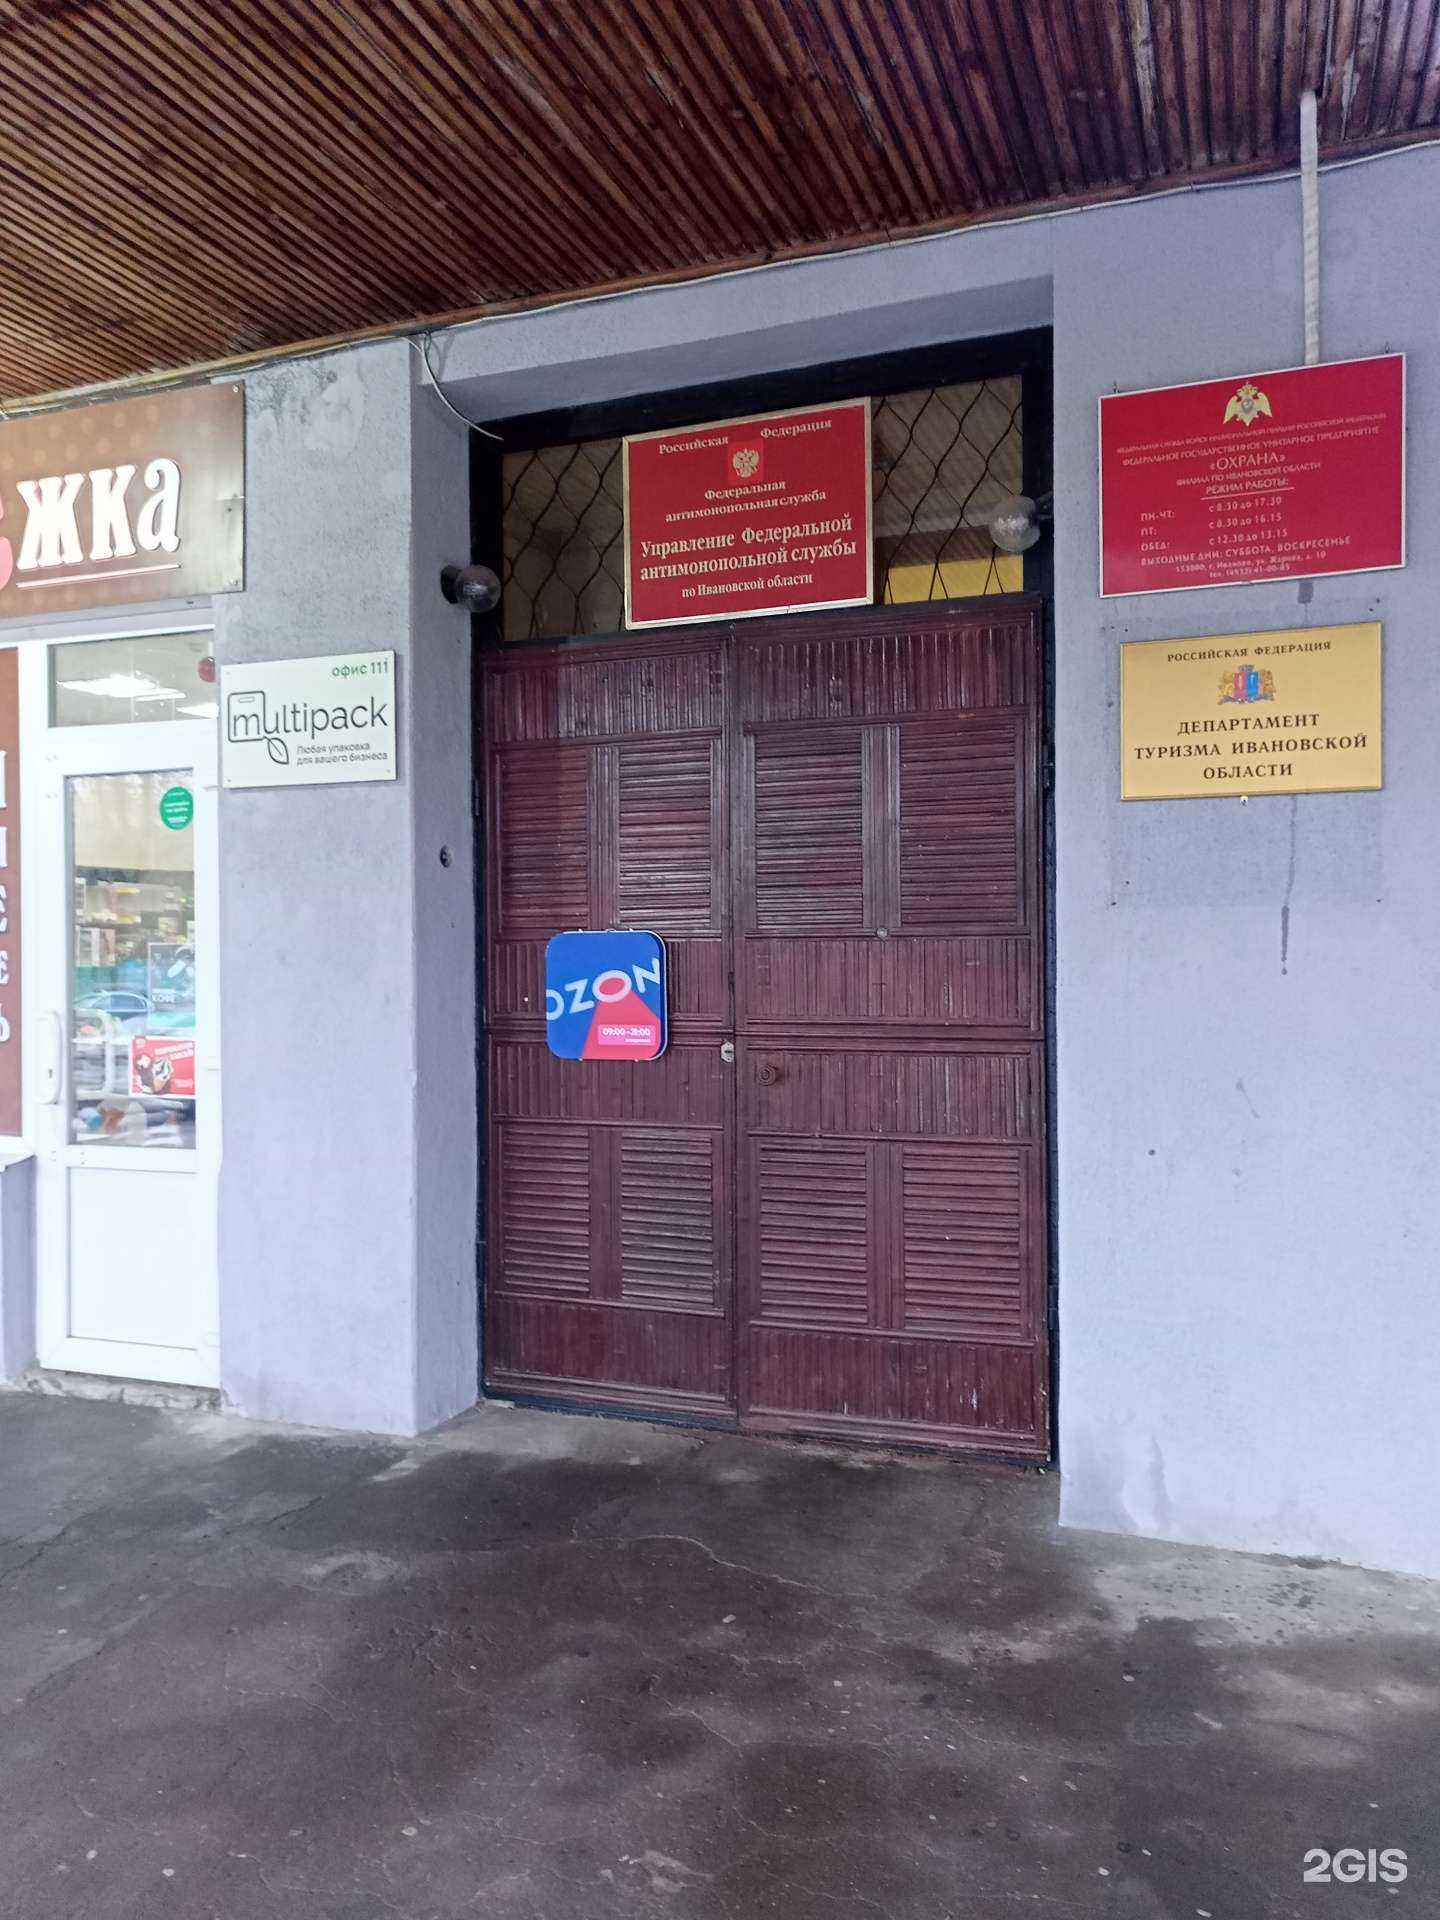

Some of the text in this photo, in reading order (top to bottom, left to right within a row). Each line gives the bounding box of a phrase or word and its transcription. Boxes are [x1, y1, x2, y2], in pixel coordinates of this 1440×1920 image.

[658, 419, 832, 455] Российская Федерация
[1210, 451, 1286, 470] «ОХРАНА»
[1211, 473, 1224, 482] ПО
[1283, 461, 1321, 473] ОБЛАСТИ
[704, 480, 786, 501] Федеральная
[1205, 478, 1289, 495] РЕЖИМ РАБОТЫ:
[665, 489, 827, 523] антимонопольная служба
[1240, 502, 1252, 510] до
[1240, 517, 1252, 526] до
[1255, 512, 1282, 523] 16.15
[640, 514, 853, 559] Управление Федеральной
[640, 538, 857, 581] антимонопольной службы
[1140, 552, 1195, 566] ВЫХОДНЫЕ
[681, 572, 813, 599] по Ивановской области
[1167, 641, 1331, 663] РОССИЙСКАЯ ФЕДЕРАЦИЯ
[331, 660, 389, 679] офис 111
[233, 696, 388, 740] multipack
[1177, 713, 1320, 736] ДЕПАРТАМЕНТ
[328, 743, 370, 753] упаковка
[349, 752, 388, 762] бизнеса
[1134, 733, 1367, 760] ТУРИЗМА ИВАНОВСКОЙ
[1203, 763, 1293, 780] ОБЛАСТИ
[546, 957, 661, 1021] OZON
